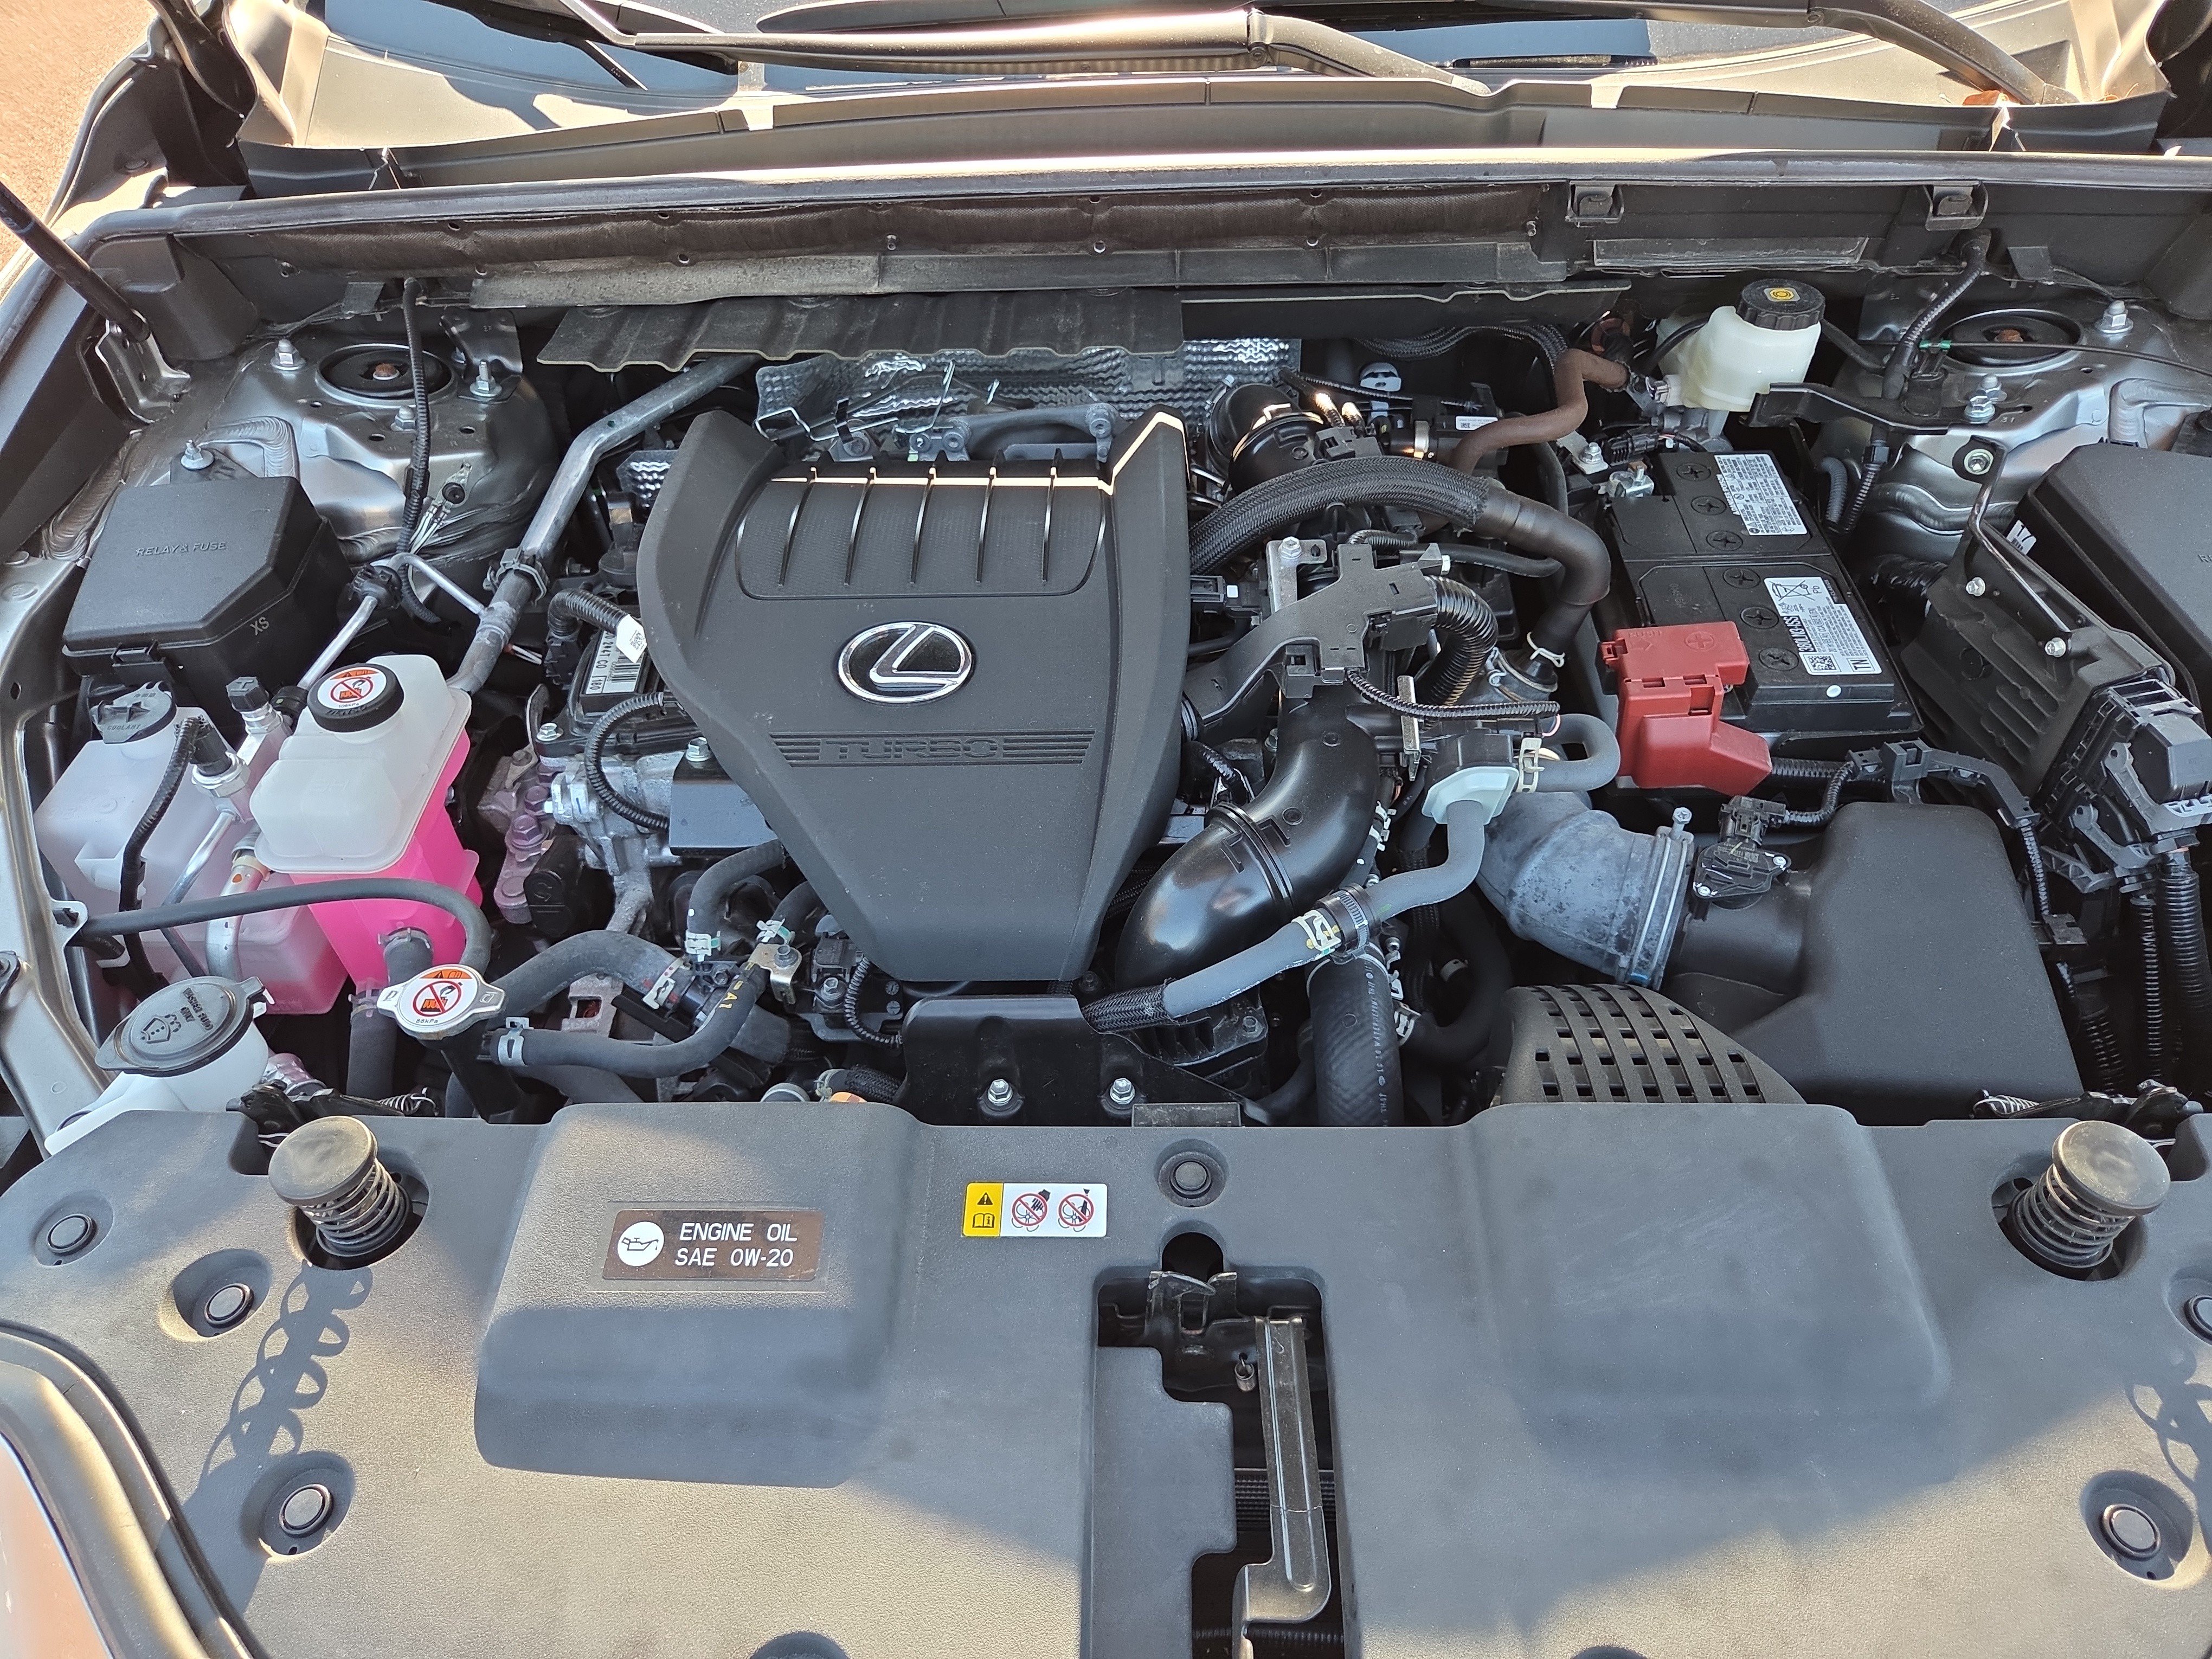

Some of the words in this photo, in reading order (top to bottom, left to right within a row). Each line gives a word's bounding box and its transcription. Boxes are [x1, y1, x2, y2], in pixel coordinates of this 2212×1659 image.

[136, 544, 179, 556] RELAY
[180, 544, 189, 552] &
[193, 542, 229, 551] FUSE
[249, 616, 270, 635] XS
[1850, 659, 1872, 671] TN
[826, 737, 999, 760] TURBO
[679, 1223, 754, 1242] ENGINE
[767, 1223, 798, 1242] OIL
[674, 1248, 718, 1266] SAE
[730, 1248, 794, 1268] 0W-20
